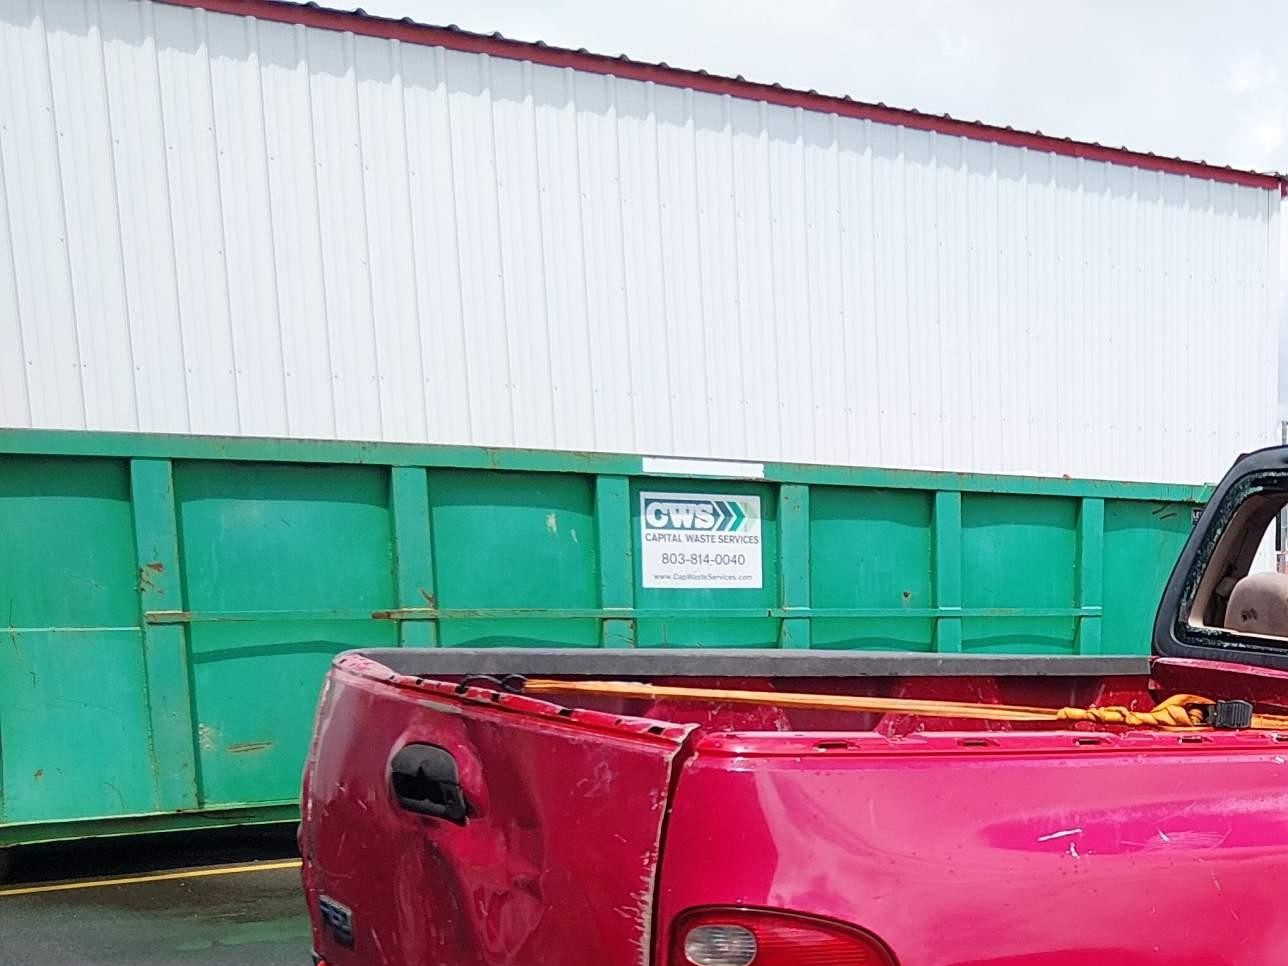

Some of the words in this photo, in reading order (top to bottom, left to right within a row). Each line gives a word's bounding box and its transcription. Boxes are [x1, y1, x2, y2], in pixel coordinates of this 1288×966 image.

[646, 501, 715, 529] CWS
[645, 532, 682, 543] CAPITAL
[685, 533, 717, 544] WASTE
[718, 534, 760, 545] SERVICES
[661, 552, 746, 566] 803-814-0040
